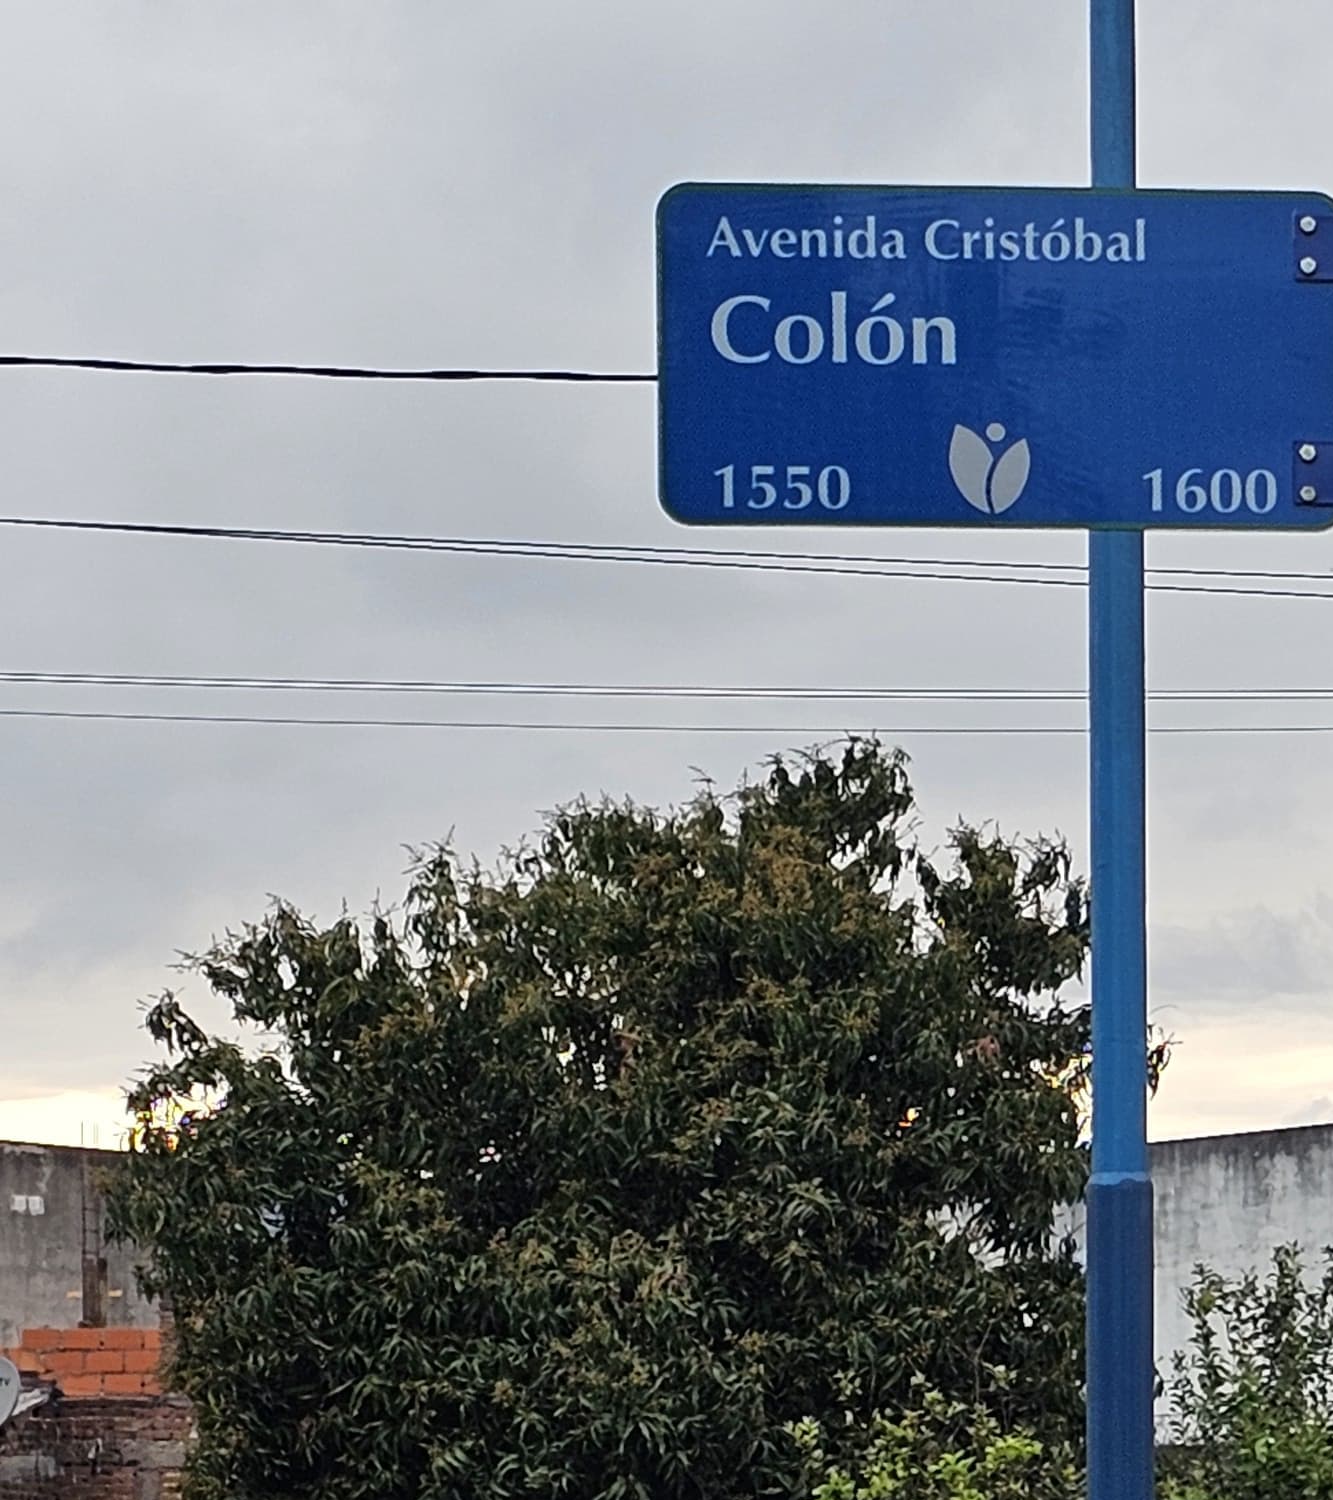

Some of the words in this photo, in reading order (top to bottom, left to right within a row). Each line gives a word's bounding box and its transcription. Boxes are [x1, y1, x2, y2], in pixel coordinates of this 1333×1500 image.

[707, 216, 906, 259] Avenida
[924, 217, 1146, 263] Cristóbal
[711, 291, 956, 365] Colón
[714, 465, 850, 509] 1550
[1143, 468, 1278, 513] 1600
